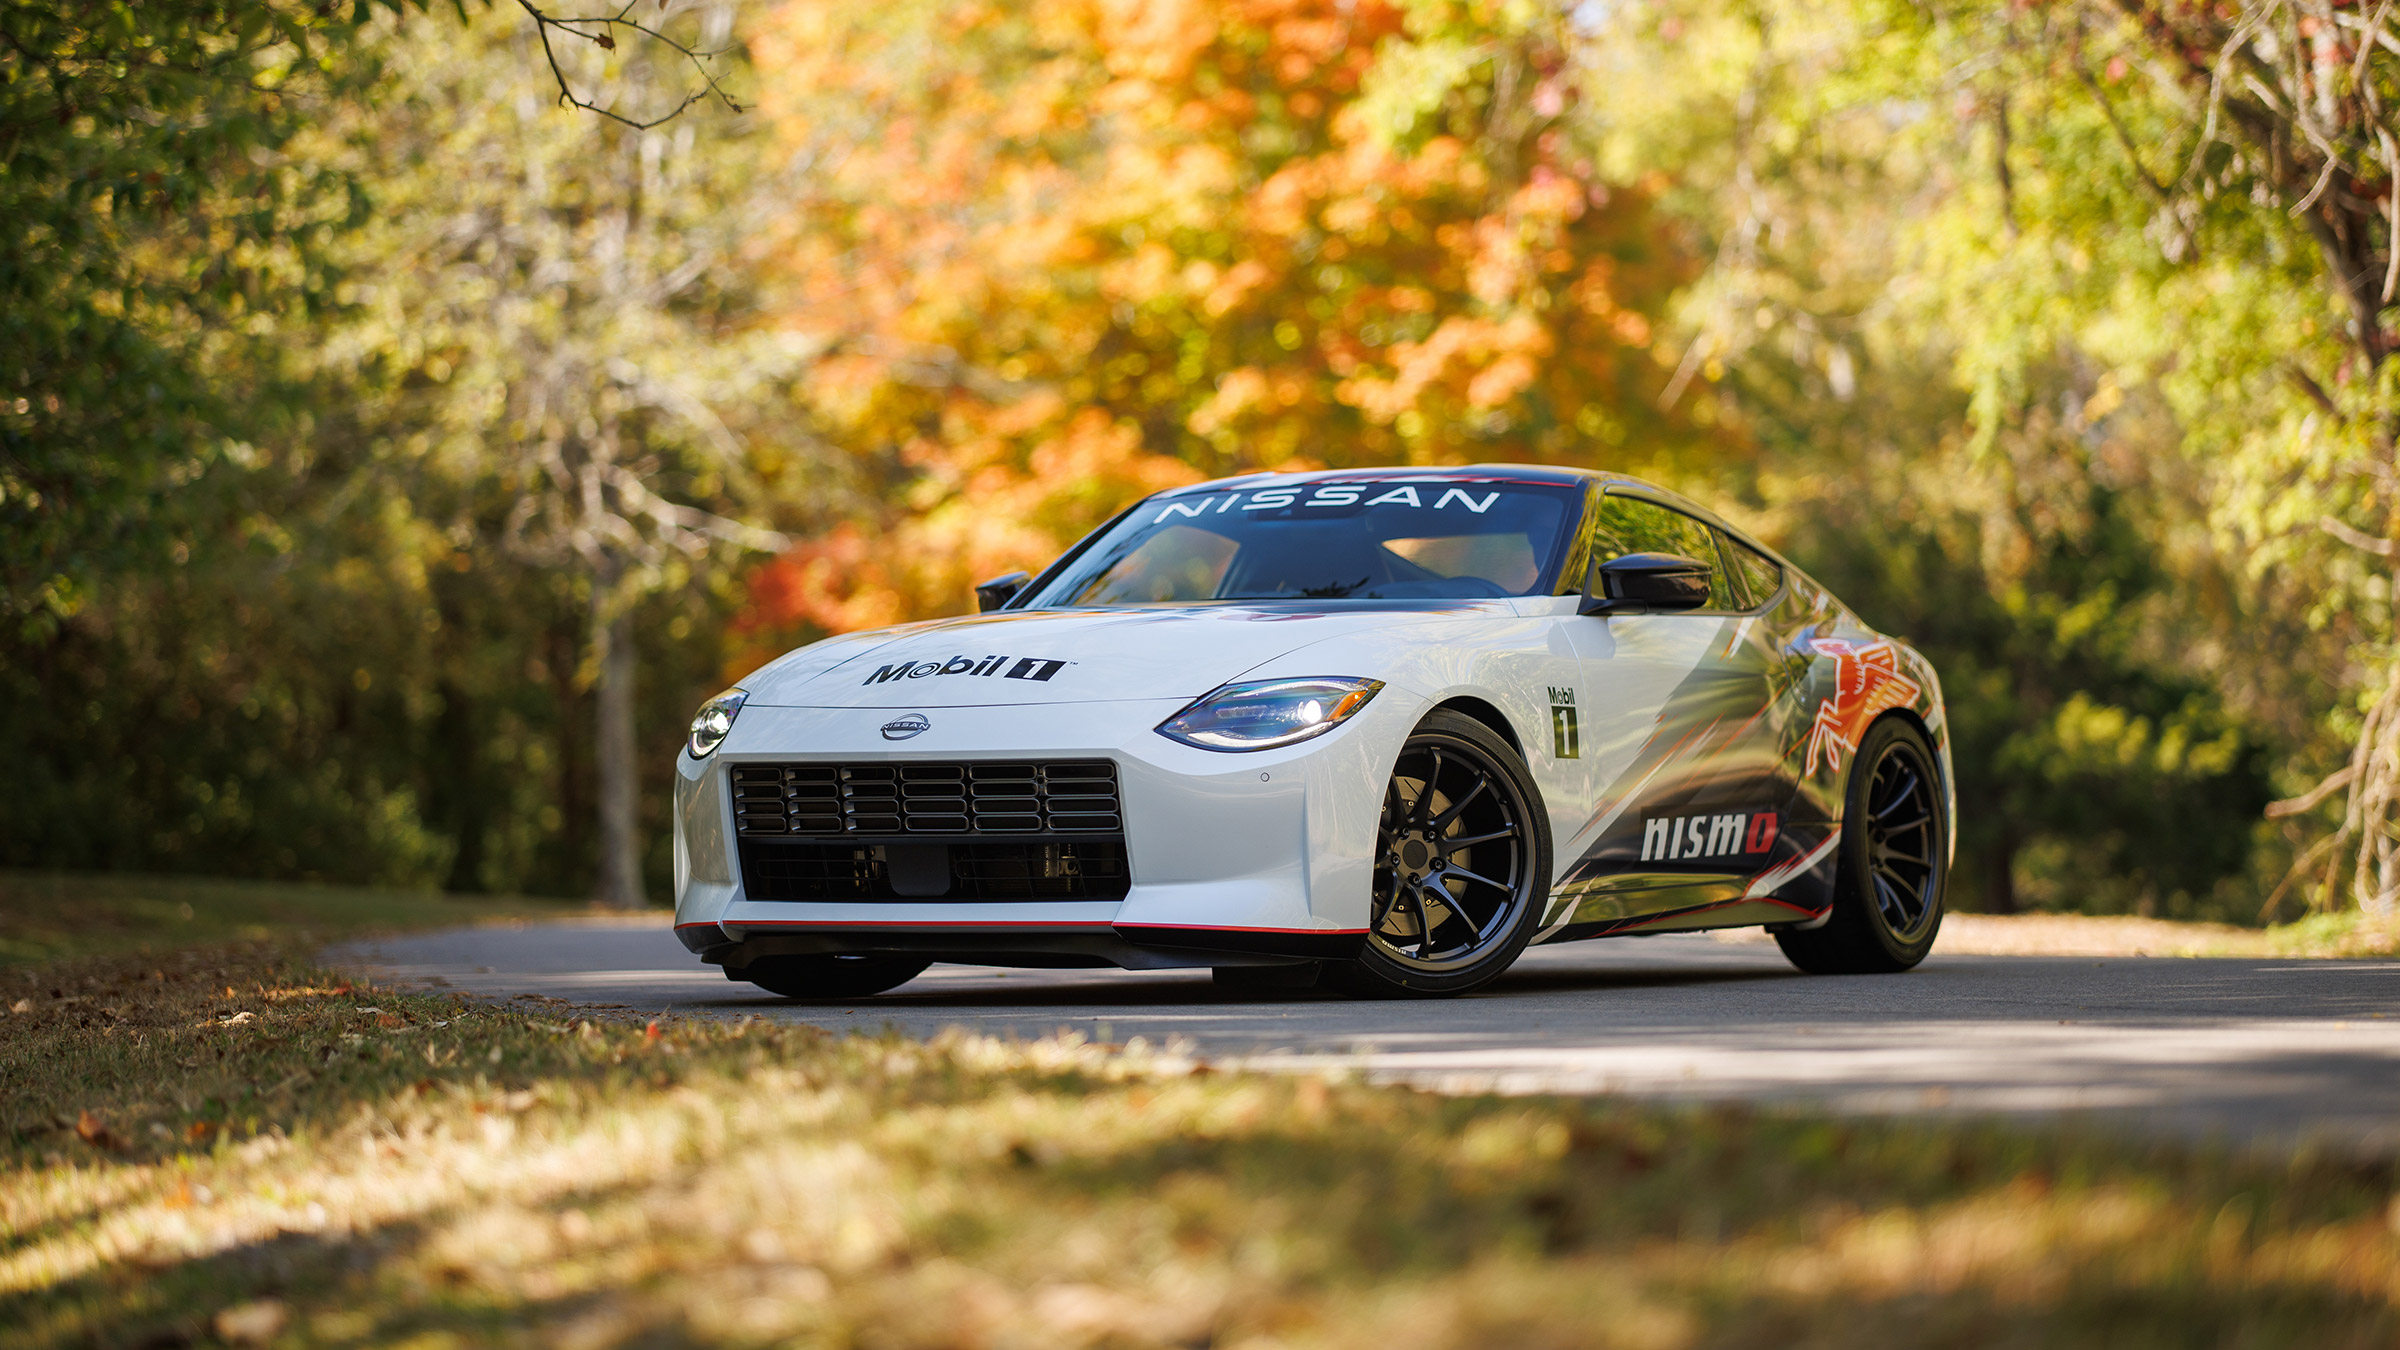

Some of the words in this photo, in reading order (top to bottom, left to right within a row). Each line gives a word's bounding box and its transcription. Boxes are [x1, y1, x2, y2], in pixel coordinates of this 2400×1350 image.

[1154, 485, 1501, 524] NISSAN
[862, 654, 1010, 686] Mobil
[1547, 686, 1576, 705] Mobil
[882, 721, 930, 730] NISSAN
[1640, 812, 1778, 862] nismo
